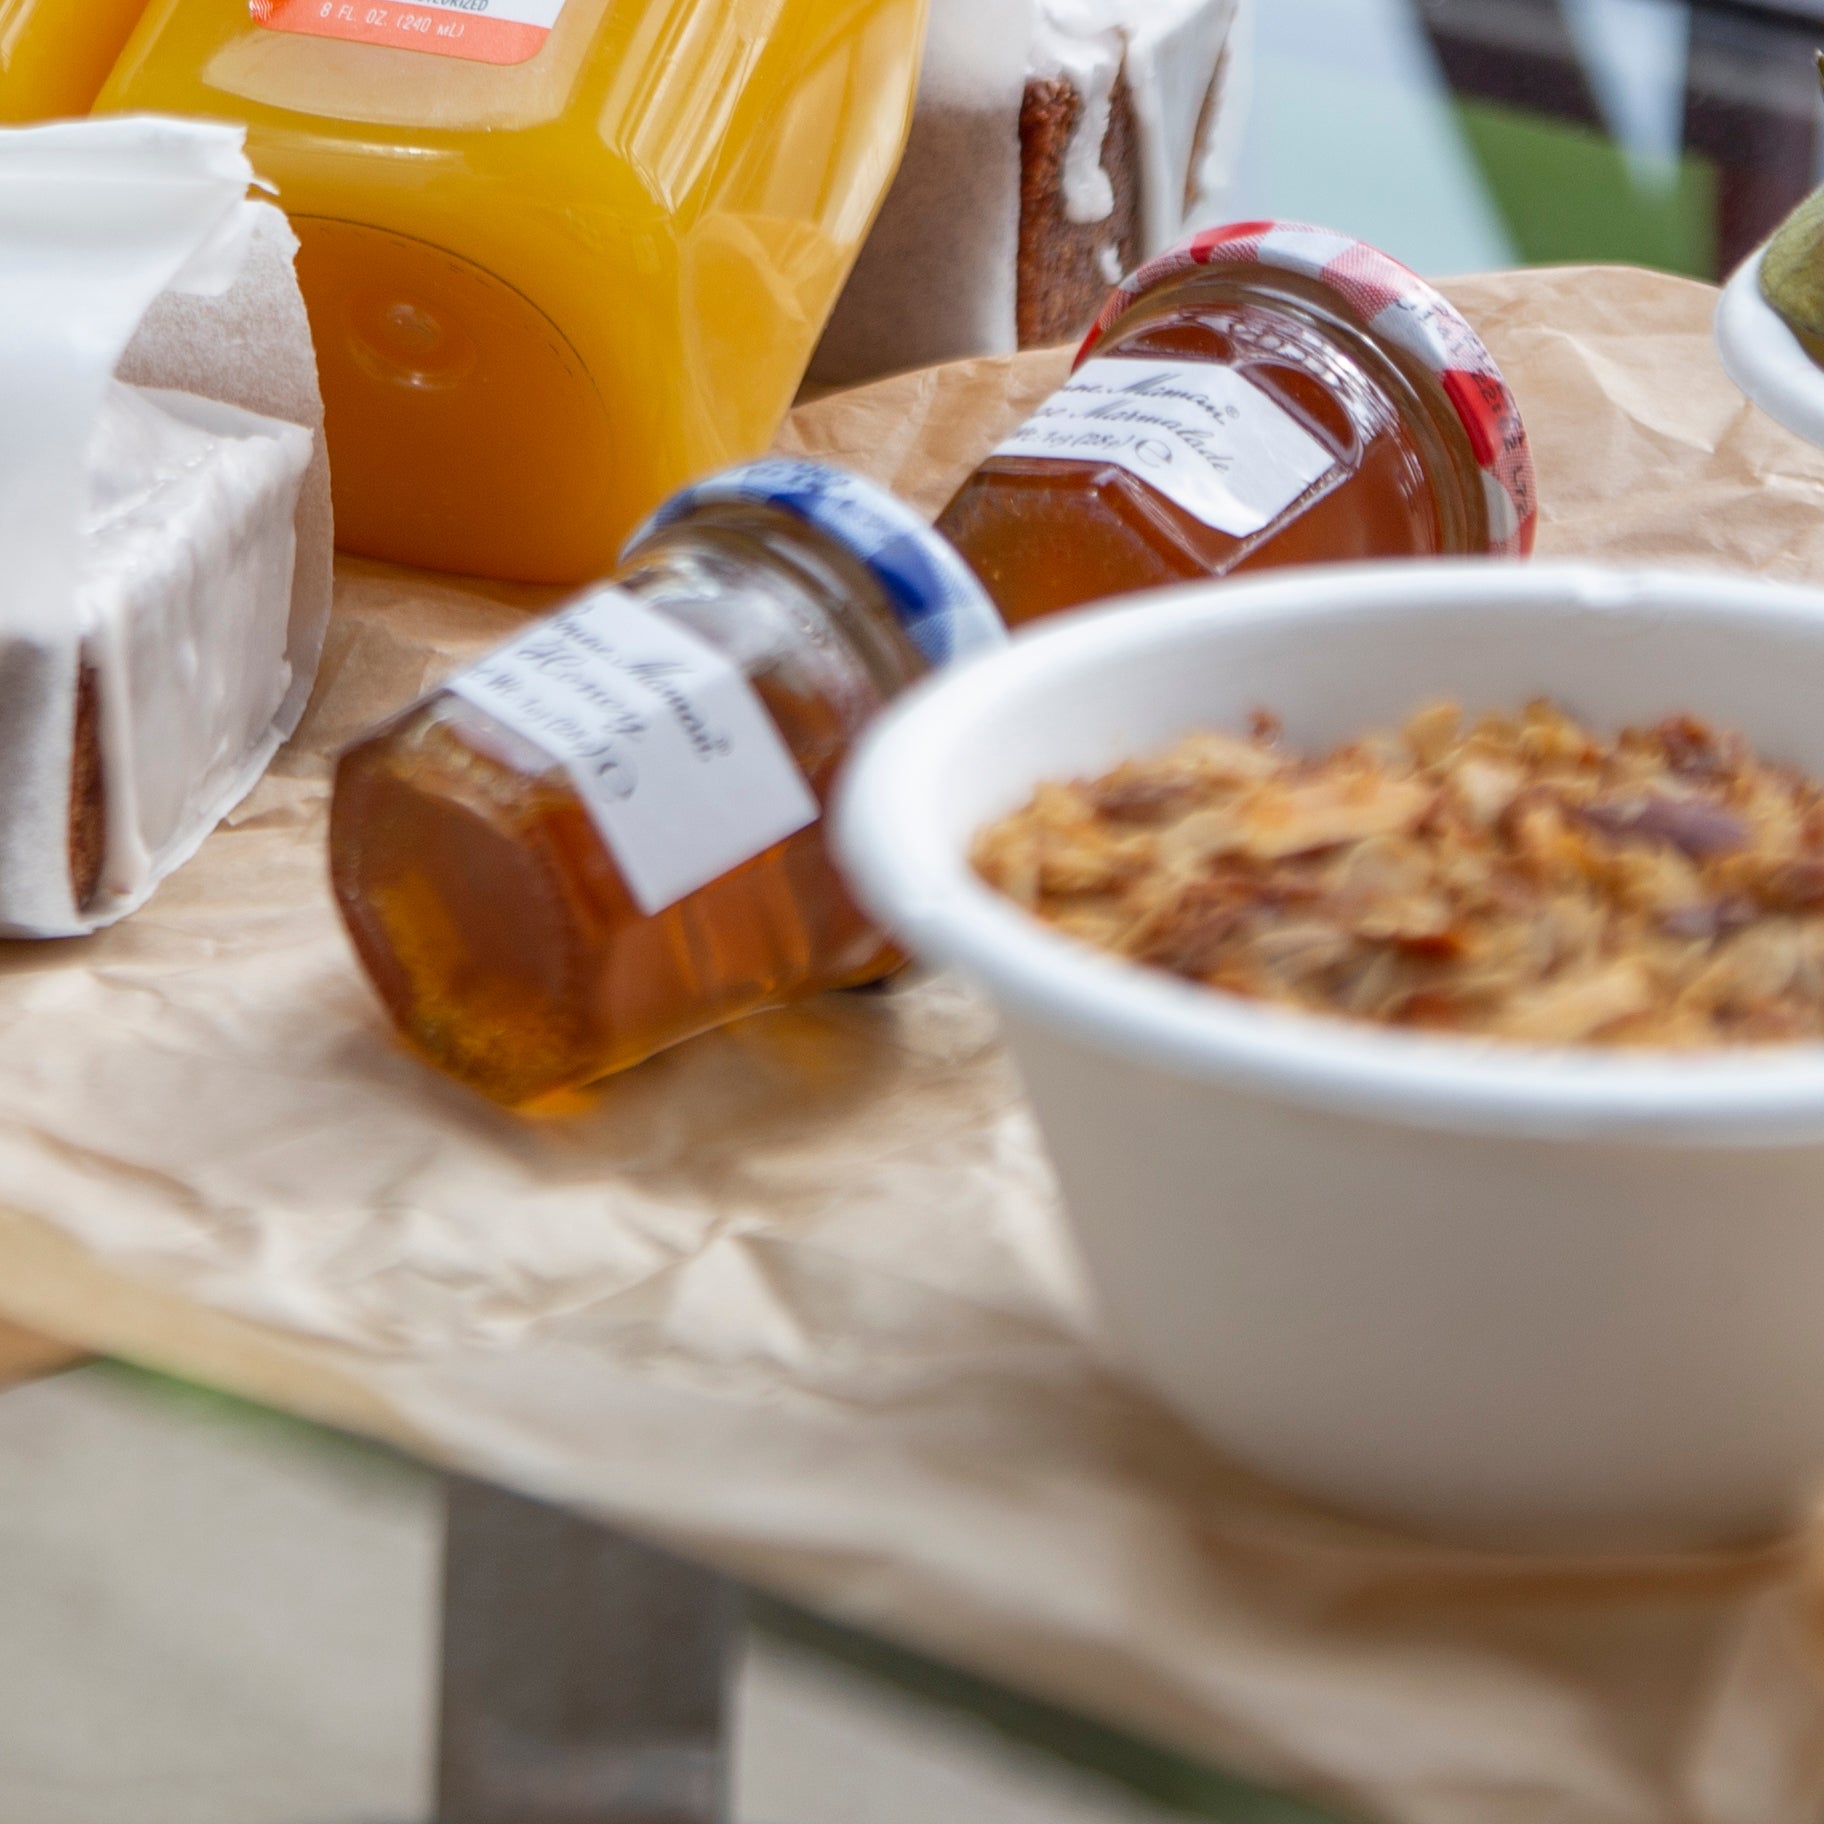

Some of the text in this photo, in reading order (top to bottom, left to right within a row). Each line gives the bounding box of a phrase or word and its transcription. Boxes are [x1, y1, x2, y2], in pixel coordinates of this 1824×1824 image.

[319, 1, 333, 18] 8
[366, 8, 388, 26] OZ.
[396, 13, 433, 33] (240
[1070, 396, 1235, 473] Marmalade
[516, 638, 648, 742] Honey
